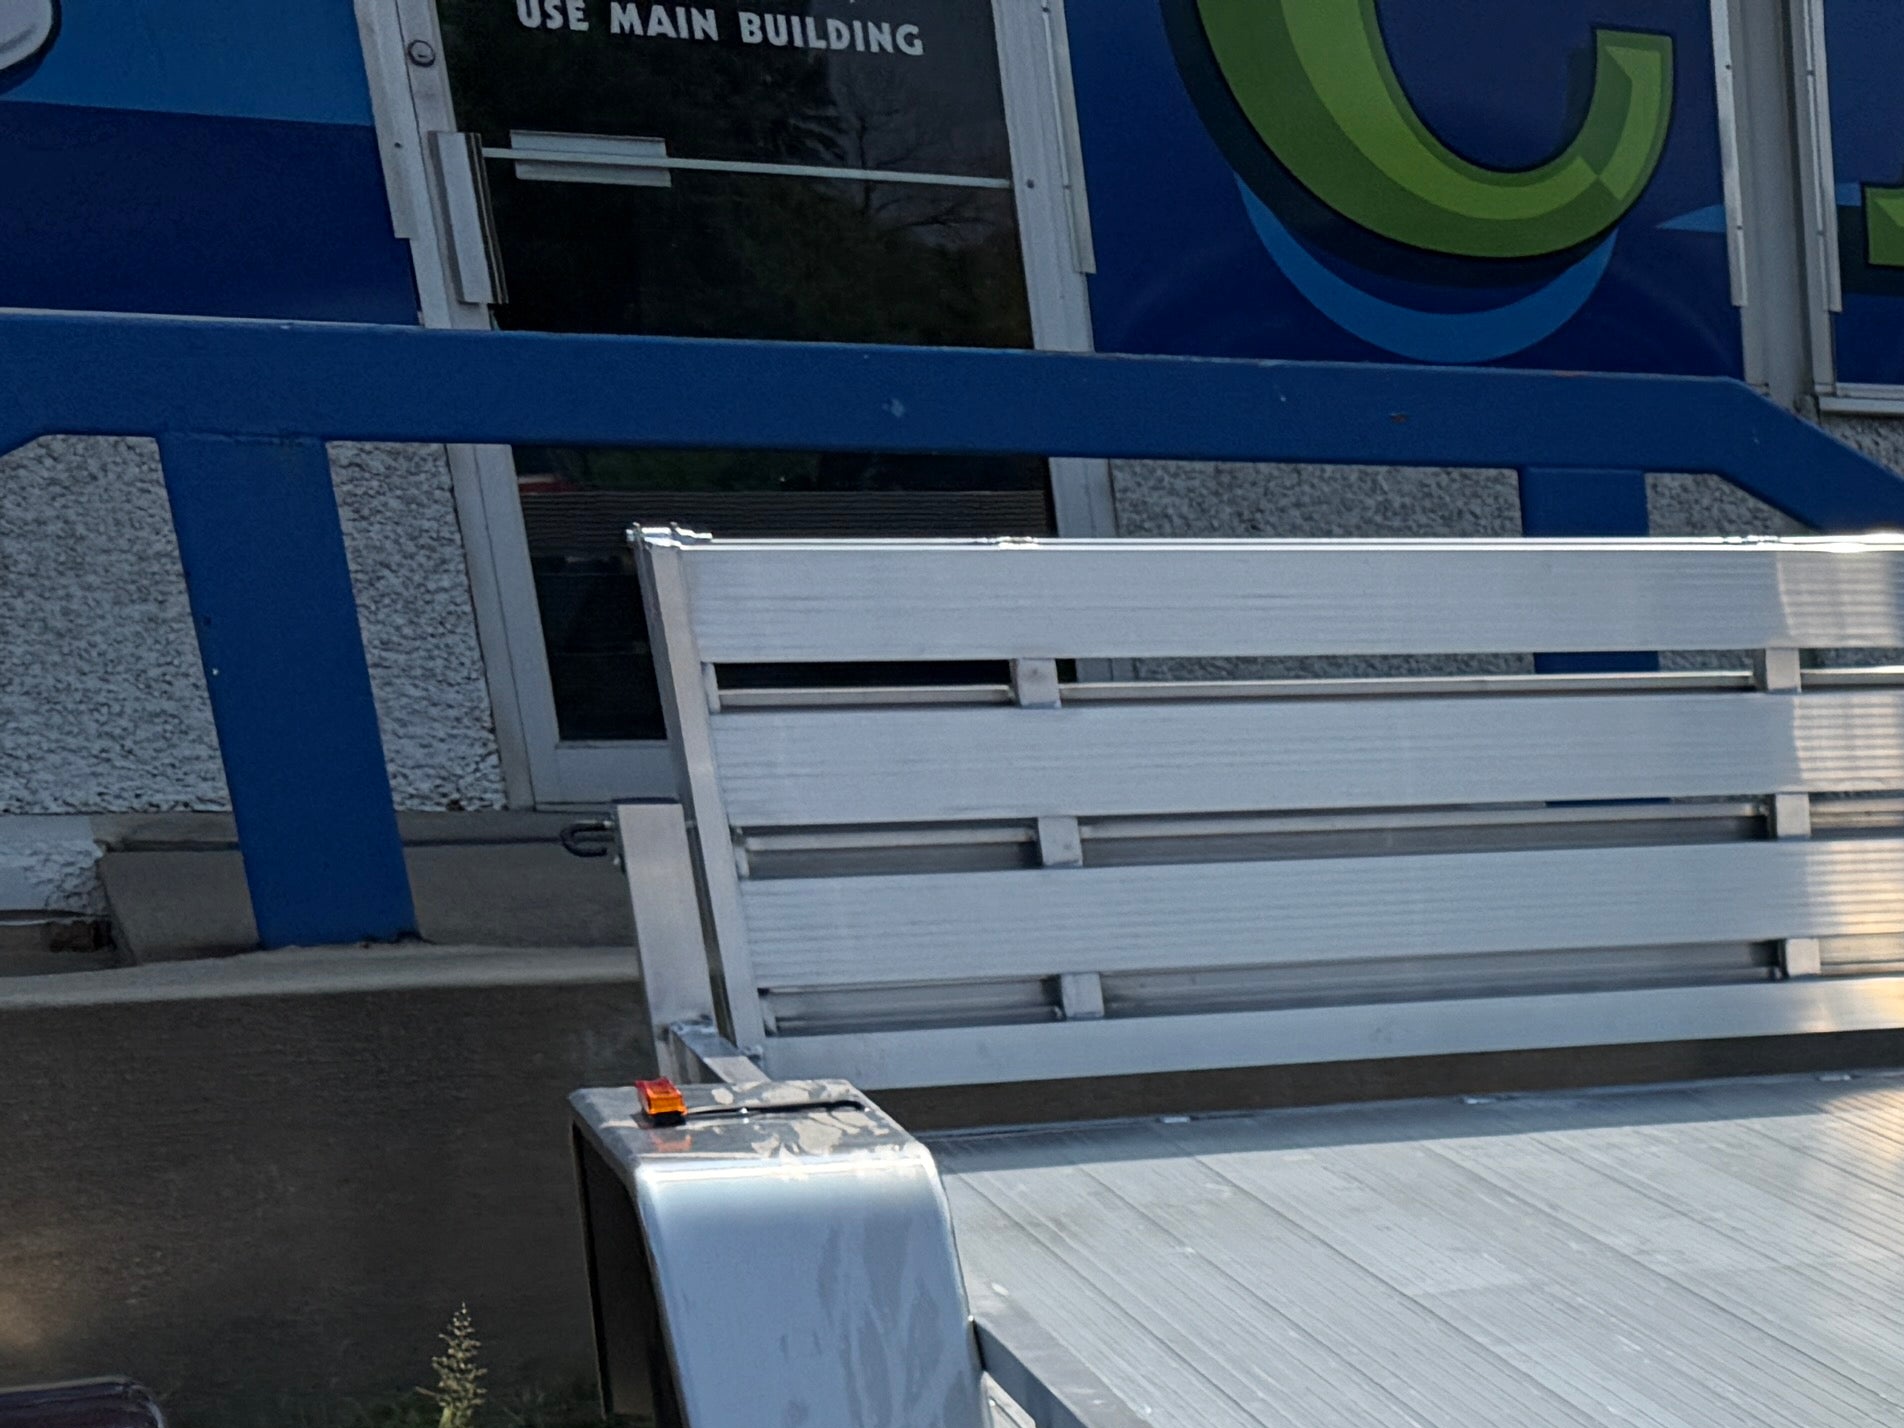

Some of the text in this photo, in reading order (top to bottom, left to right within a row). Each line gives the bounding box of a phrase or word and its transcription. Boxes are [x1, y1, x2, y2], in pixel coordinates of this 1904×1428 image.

[517, 0, 924, 55] USE MAIN BUILDING
